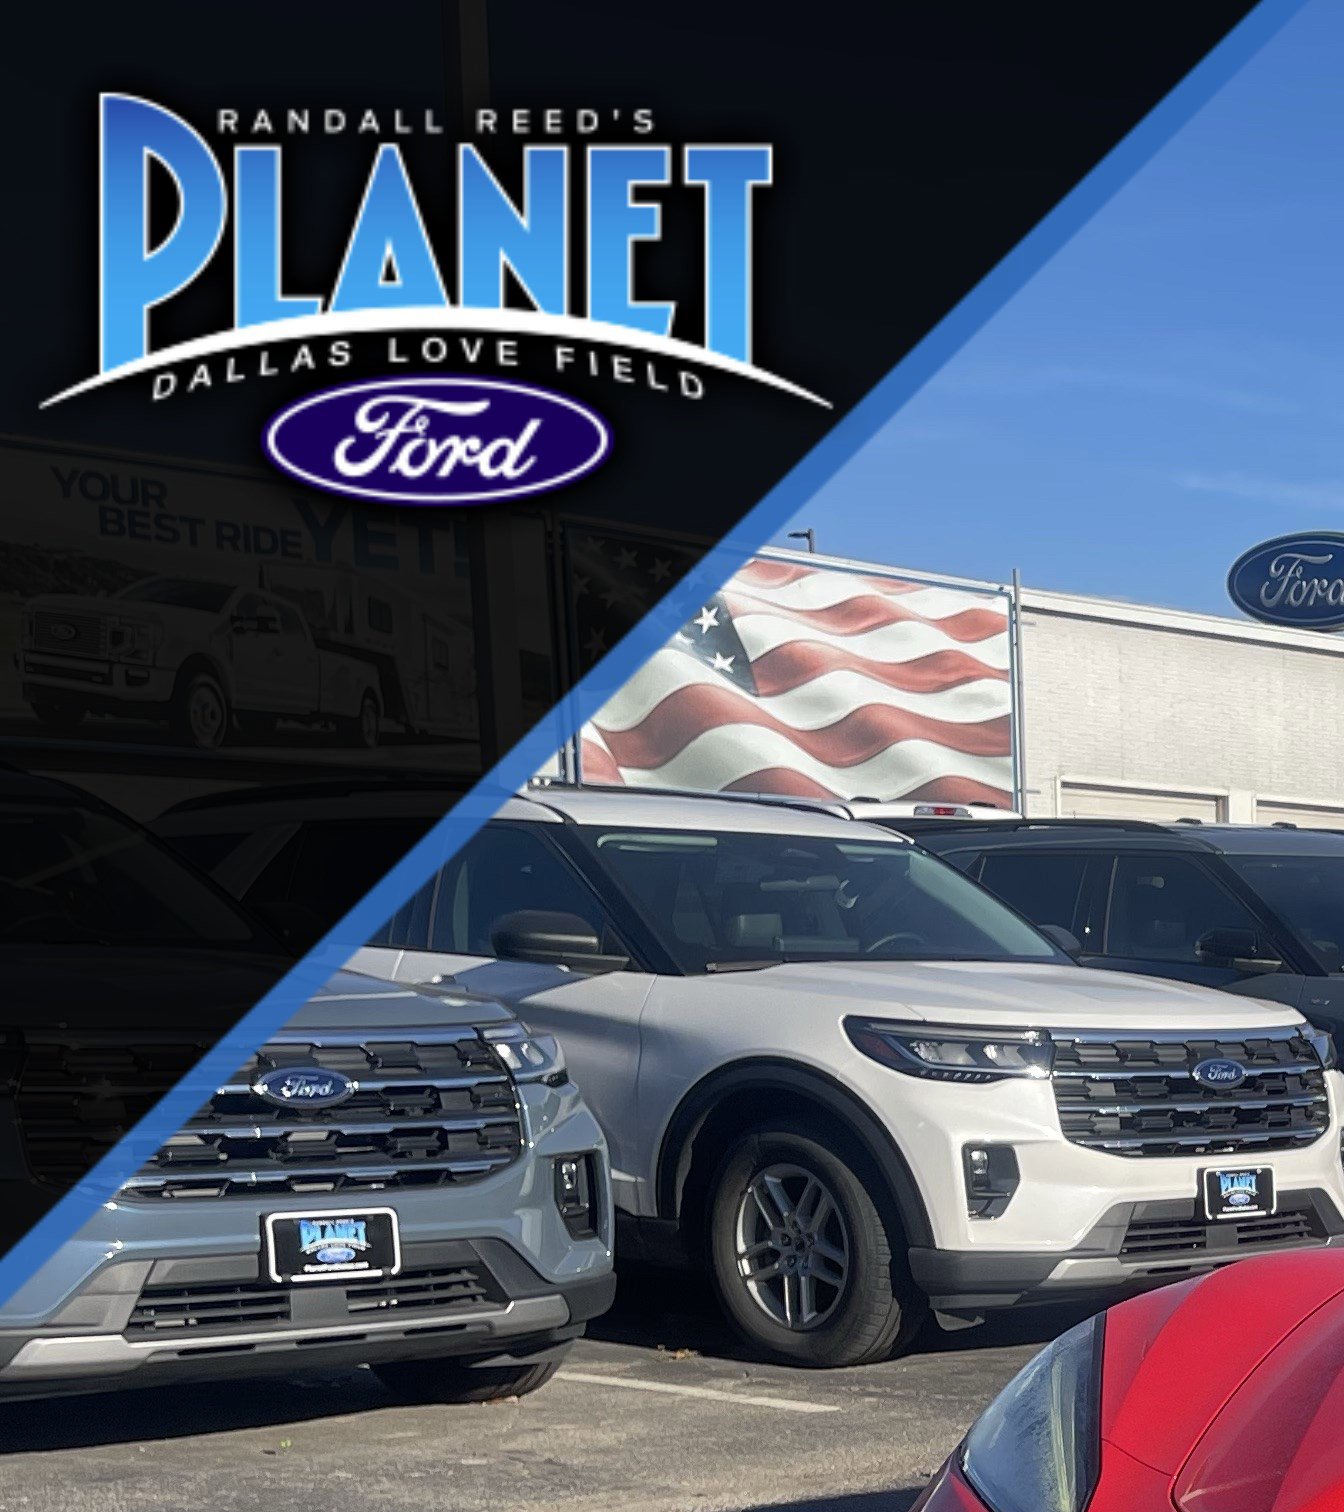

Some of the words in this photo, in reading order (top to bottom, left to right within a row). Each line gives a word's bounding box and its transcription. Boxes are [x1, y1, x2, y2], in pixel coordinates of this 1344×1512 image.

[50, 464, 168, 510] YOUR
[99, 505, 205, 547] BEST
[215, 520, 302, 559] RIDE
[281, 1075, 334, 1097] Ford
[1207, 1064, 1236, 1080] Ford
